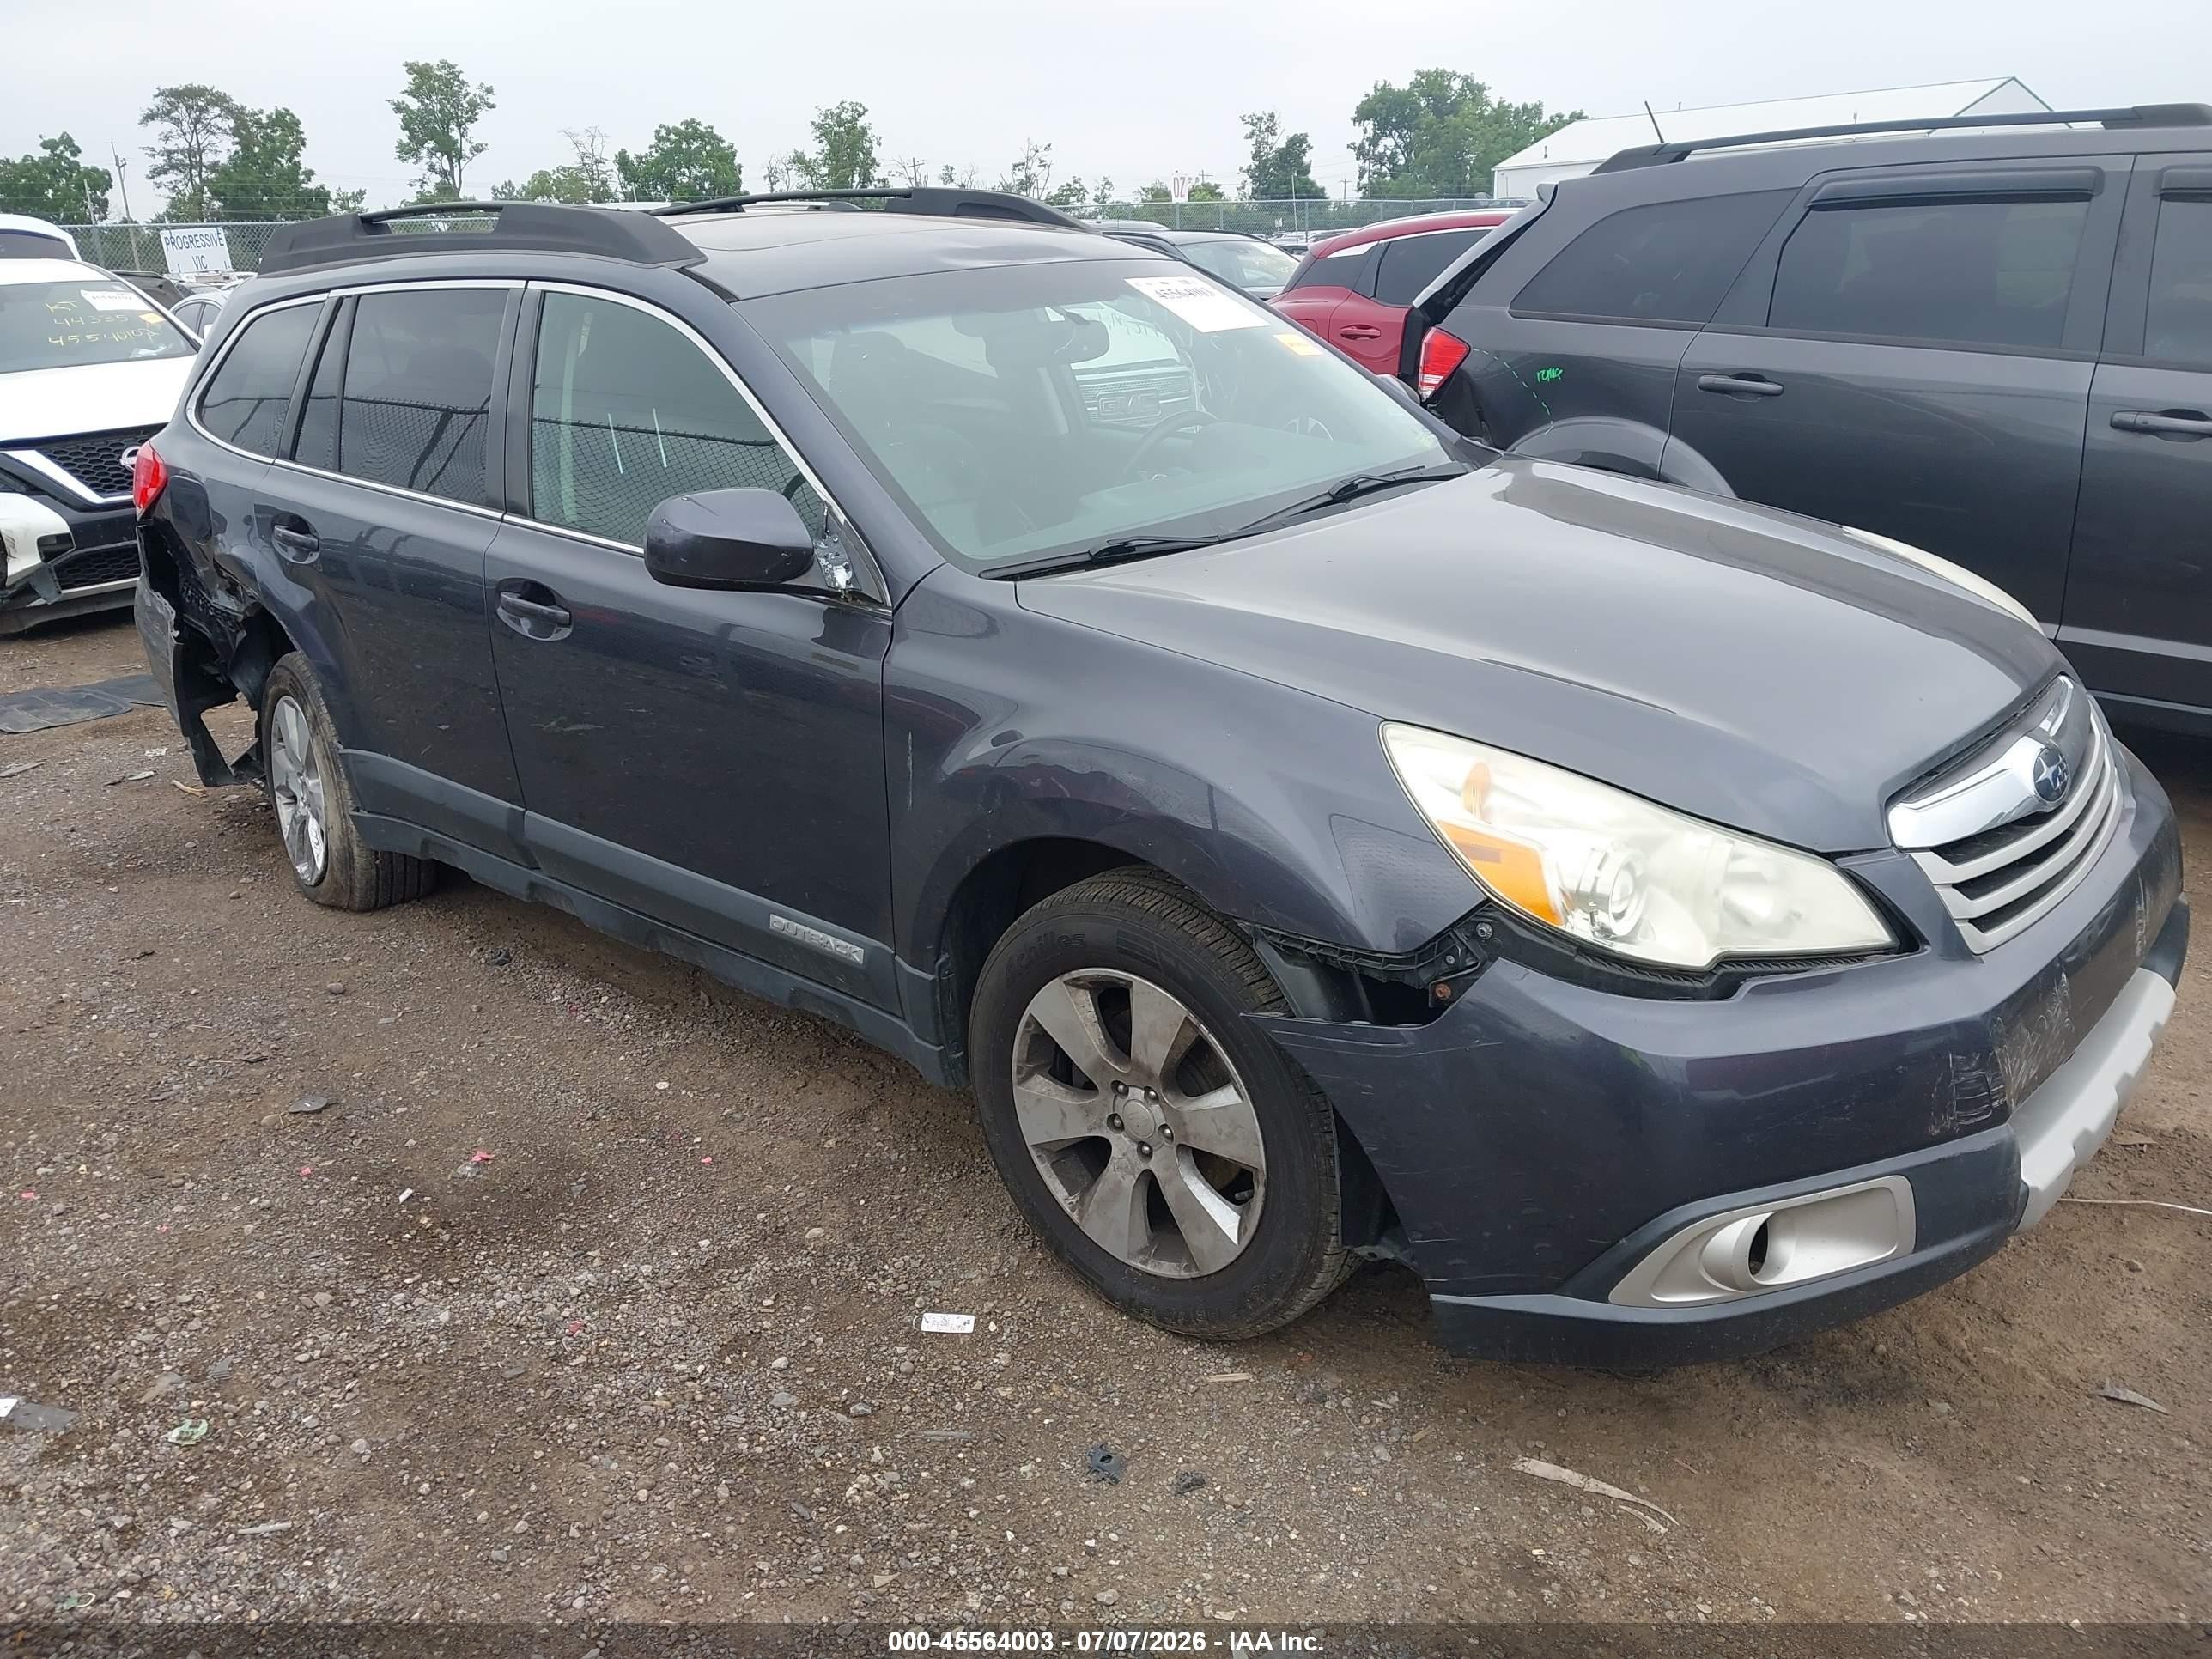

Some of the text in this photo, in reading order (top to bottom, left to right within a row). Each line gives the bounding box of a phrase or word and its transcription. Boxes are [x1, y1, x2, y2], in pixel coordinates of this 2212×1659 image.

[164, 231, 225, 251] PROGRESSIVE
[191, 254, 208, 270] VIC
[772, 919, 861, 963] OUTBACK
